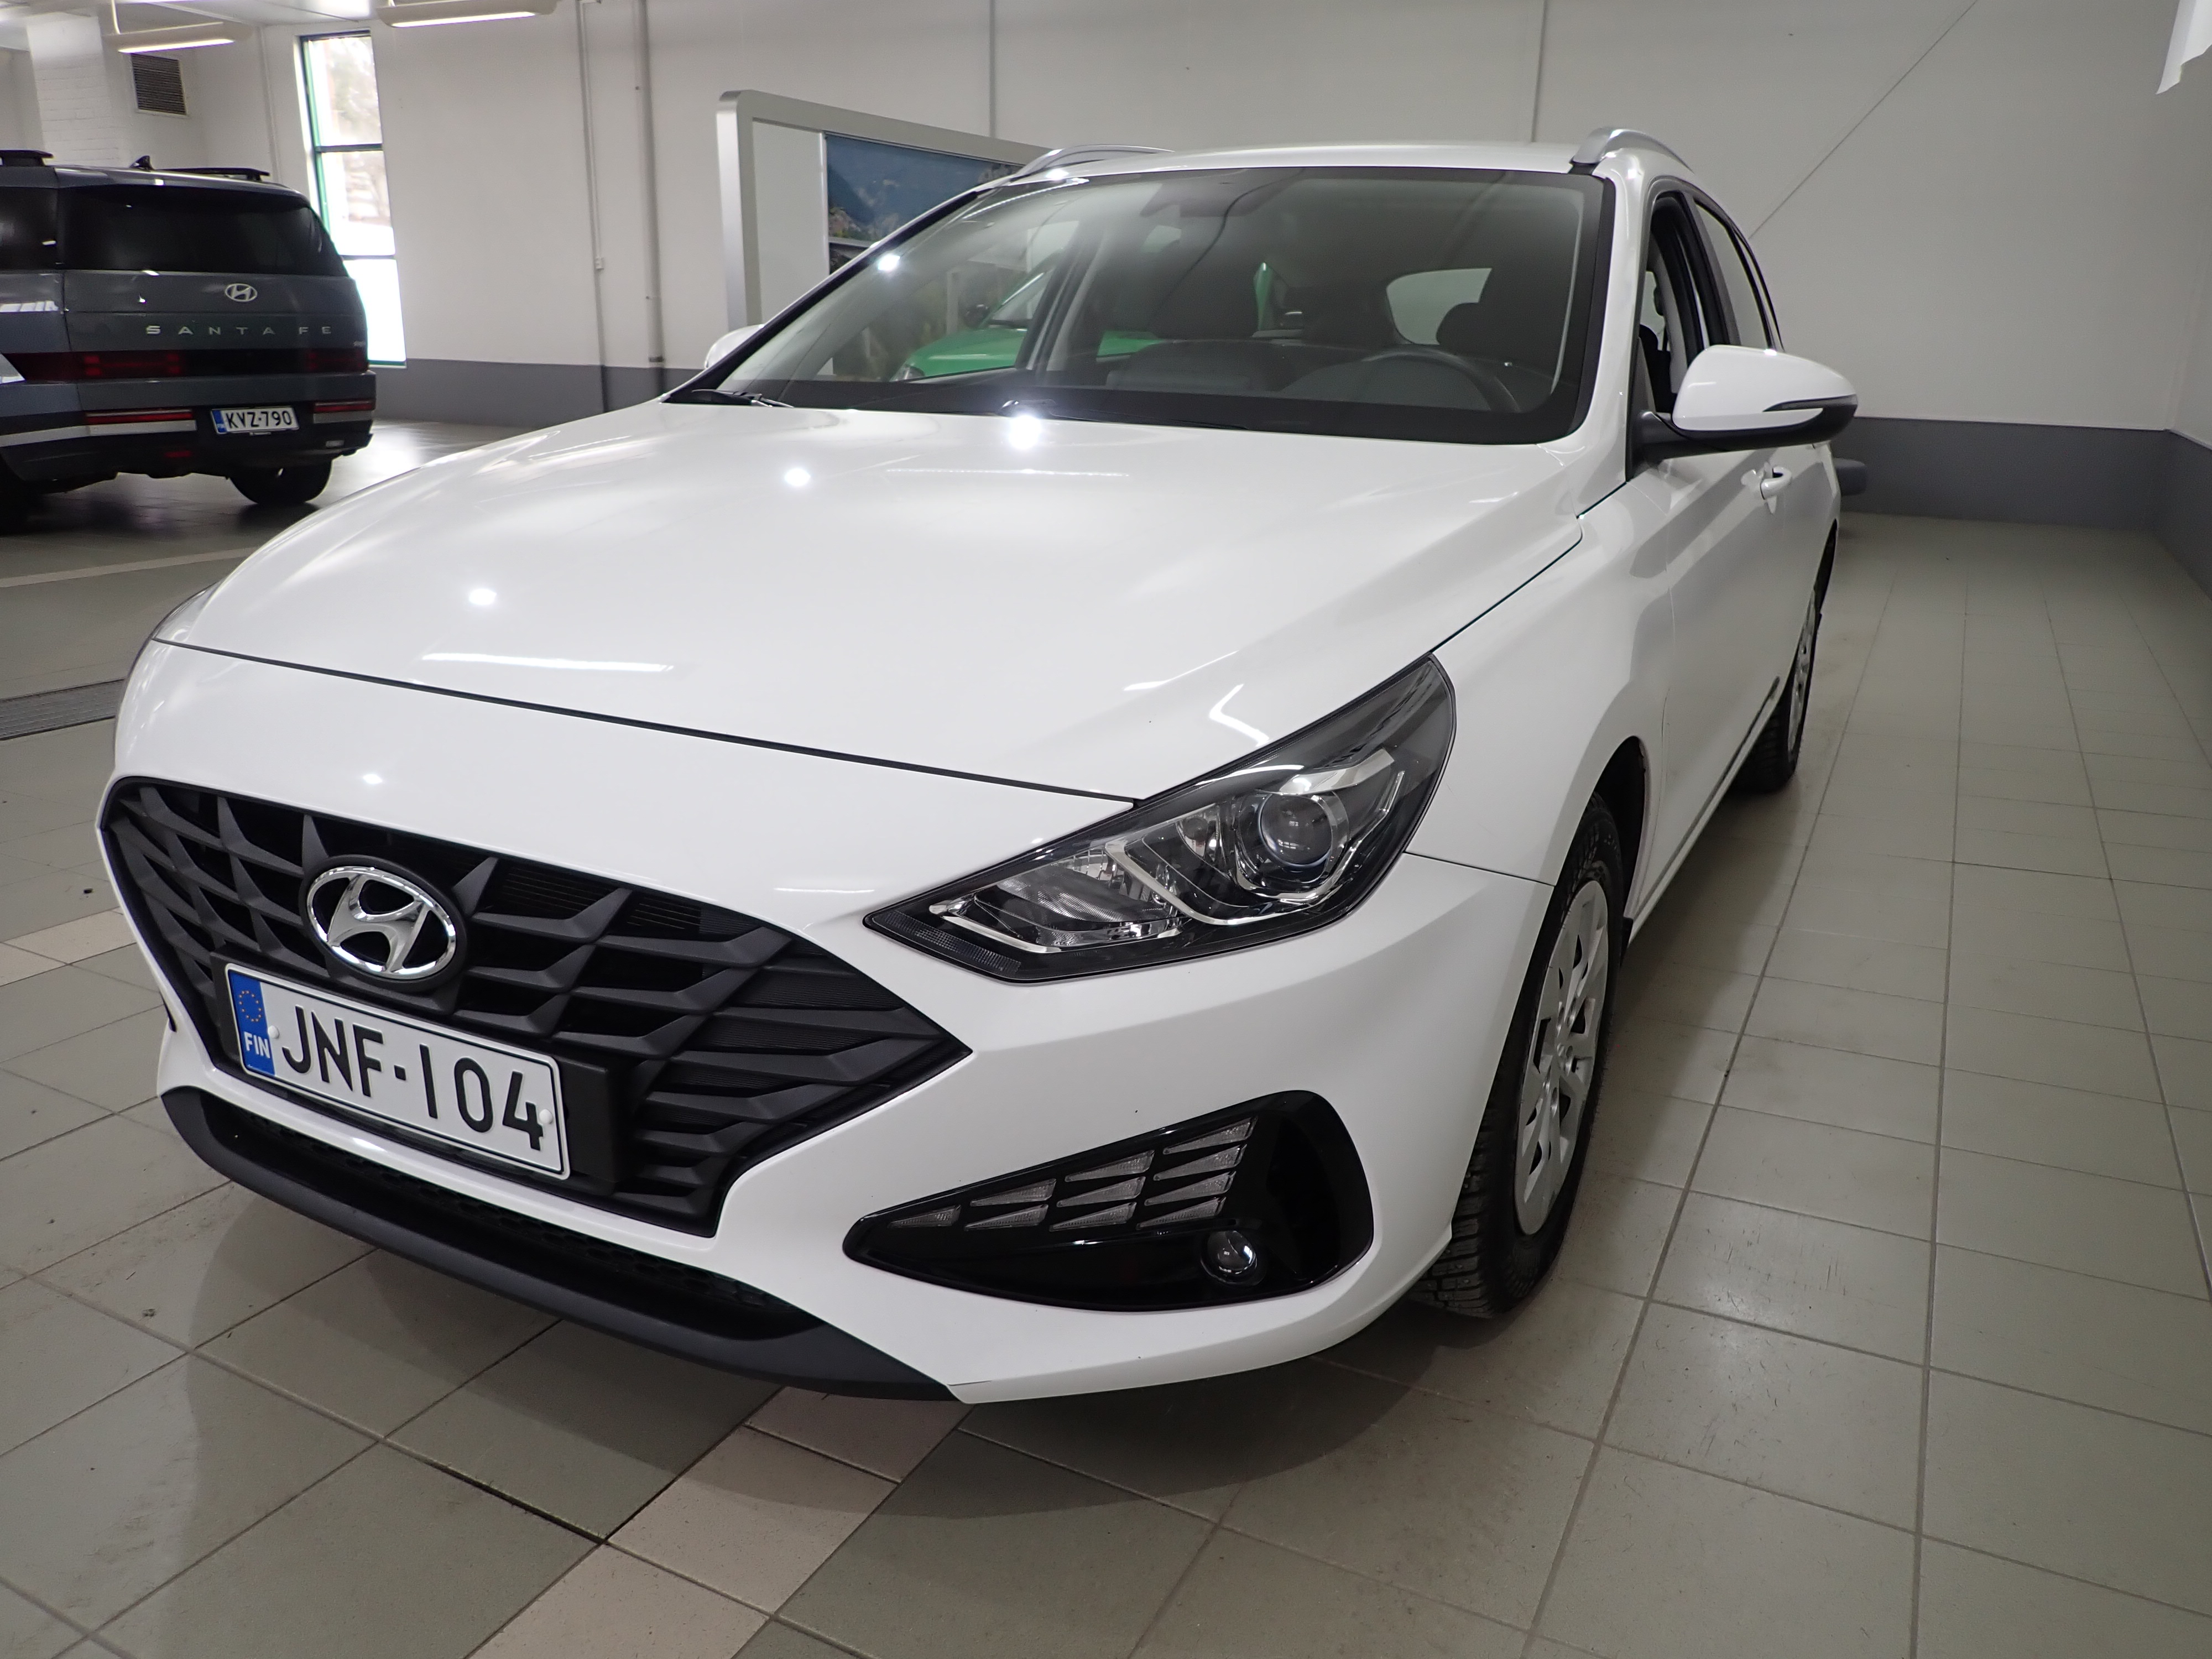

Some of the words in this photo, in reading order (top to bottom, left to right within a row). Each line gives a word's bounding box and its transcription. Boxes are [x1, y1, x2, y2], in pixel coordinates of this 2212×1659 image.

[146, 325, 275, 335] SANTA
[298, 326, 332, 335] FE
[226, 410, 292, 429] KVZ-790
[243, 1031, 271, 1059] FIN
[281, 1005, 544, 1151] JNF-104
